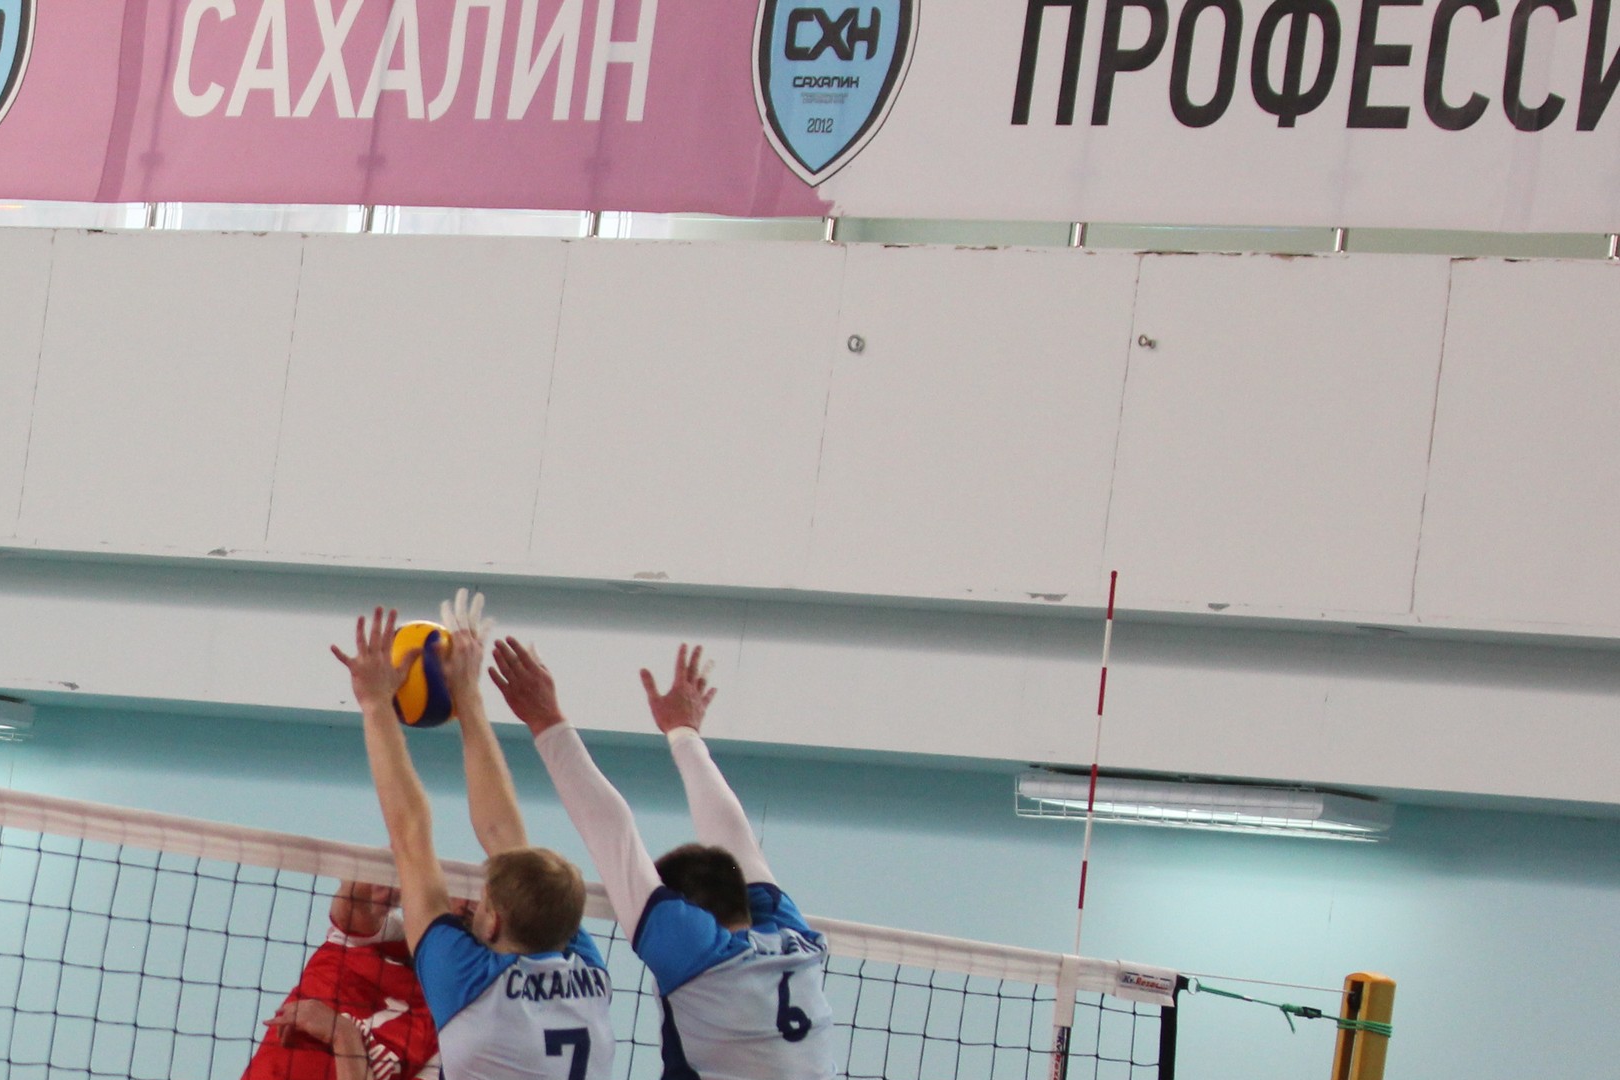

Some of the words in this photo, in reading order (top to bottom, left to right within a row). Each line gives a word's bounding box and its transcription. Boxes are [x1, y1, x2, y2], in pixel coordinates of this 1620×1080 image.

[172, 0, 659, 121] САХАЛИН
[792, 75, 861, 88] САХАЛИН
[806, 117, 835, 134] 2012
[776, 970, 813, 1043] 6
